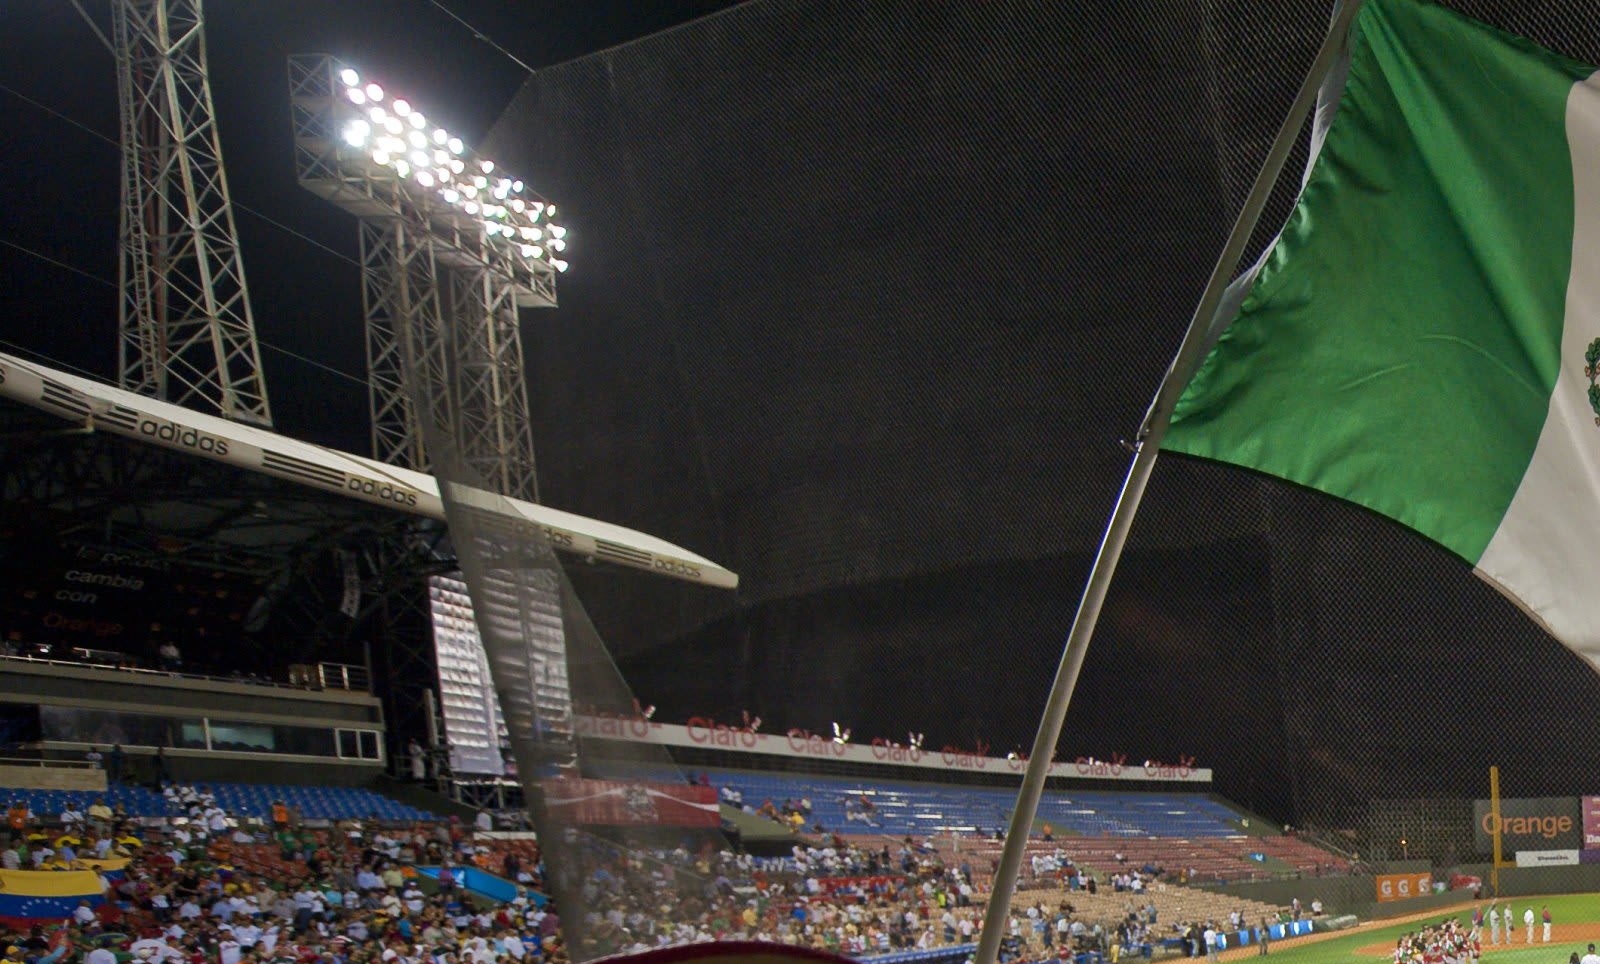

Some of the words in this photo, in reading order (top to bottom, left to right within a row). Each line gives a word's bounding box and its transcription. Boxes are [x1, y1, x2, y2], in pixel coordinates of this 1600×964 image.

[140, 417, 229, 456] adidas
[348, 475, 416, 507] adidas
[64, 569, 145, 590] cambia
[654, 558, 701, 577] adidas
[55, 589, 100, 604] con
[686, 716, 757, 748] Claro
[787, 728, 845, 756] Claro
[871, 736, 921, 764] Claro
[942, 745, 986, 769] Claro
[1076, 755, 1121, 777] Claro
[1144, 757, 1189, 779] Claro
[1481, 812, 1573, 838] Orange
